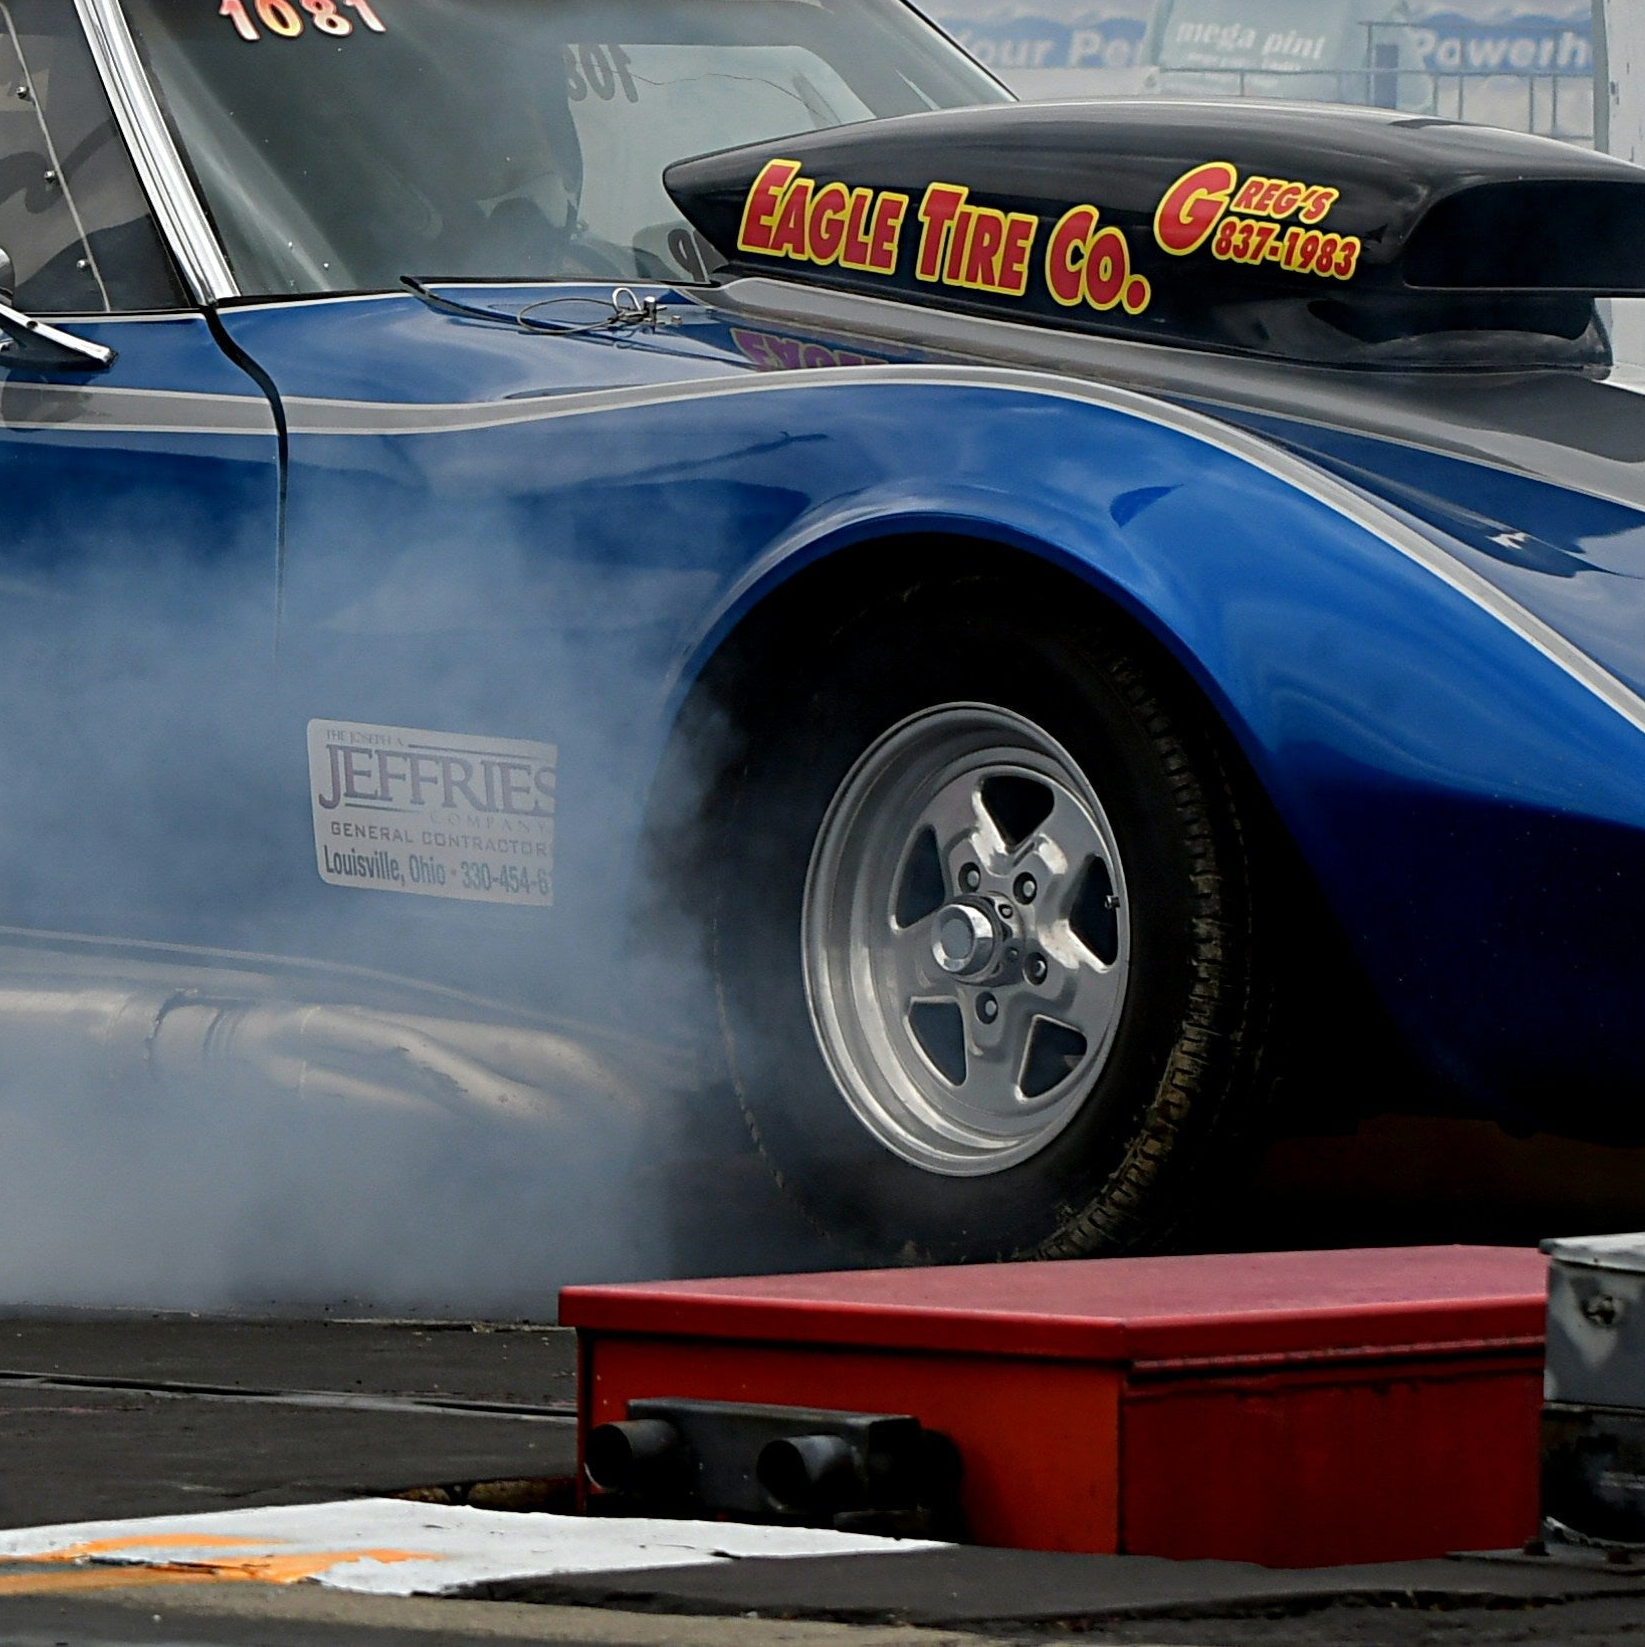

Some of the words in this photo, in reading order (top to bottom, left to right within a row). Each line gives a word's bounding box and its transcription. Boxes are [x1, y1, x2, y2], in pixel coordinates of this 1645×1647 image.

[737, 159, 909, 275] EAGLE
[915, 182, 1038, 296] TIRE
[1045, 205, 1152, 315] CO.
[1153, 161, 1340, 256] GREG'S
[1211, 215, 1361, 281] 837-1983
[325, 728, 348, 742] THE
[318, 743, 556, 818] JEFFRIES
[330, 820, 414, 844] GENERAL
[323, 845, 406, 887] Louisville,
[409, 854, 447, 886] Ohio
